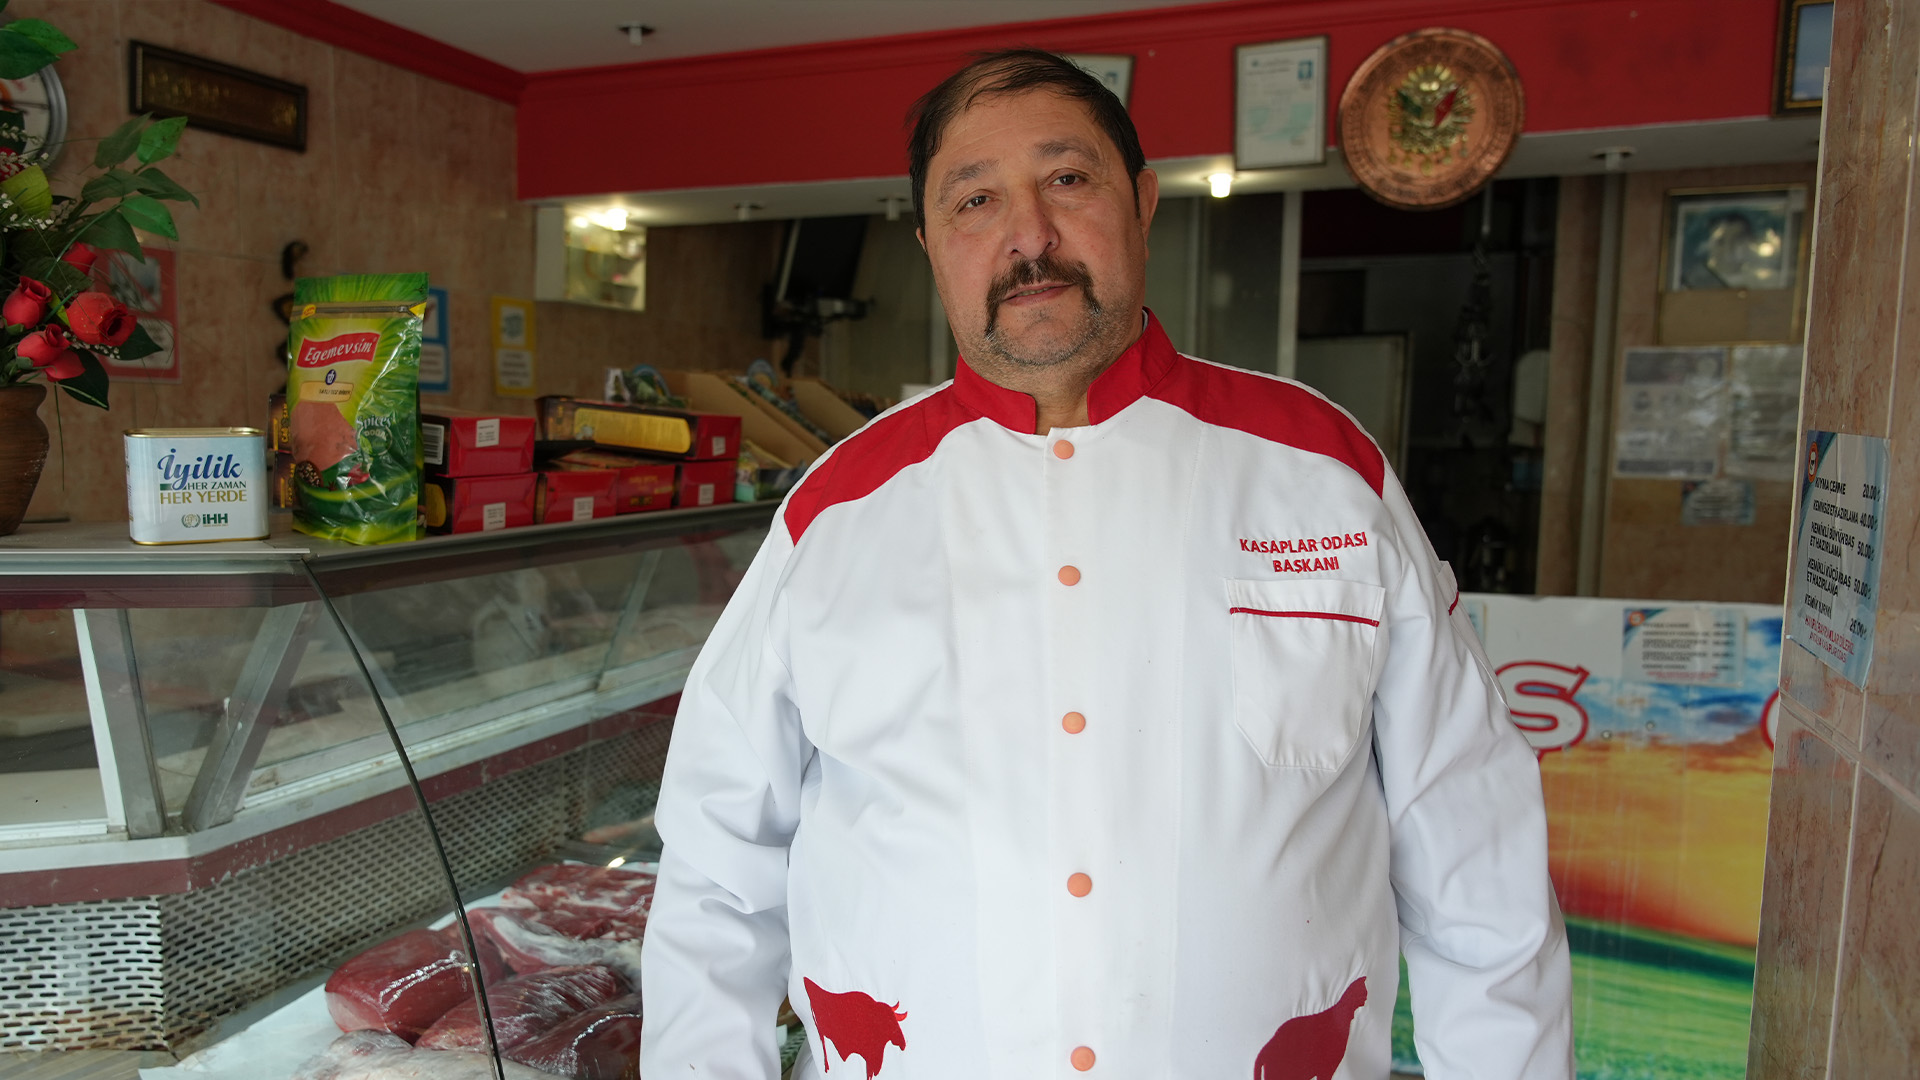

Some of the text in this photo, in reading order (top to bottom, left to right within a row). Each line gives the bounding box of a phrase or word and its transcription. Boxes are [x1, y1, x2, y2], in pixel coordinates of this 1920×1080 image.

[304, 338, 373, 365] Egemevsim
[157, 448, 243, 490] İyilik
[211, 481, 247, 490] ZAMAN
[160, 490, 247, 504] HER YERDE
[1239, 531, 1368, 554] KASAPLAR ODASI
[1272, 556, 1340, 573] BAŞKANI
